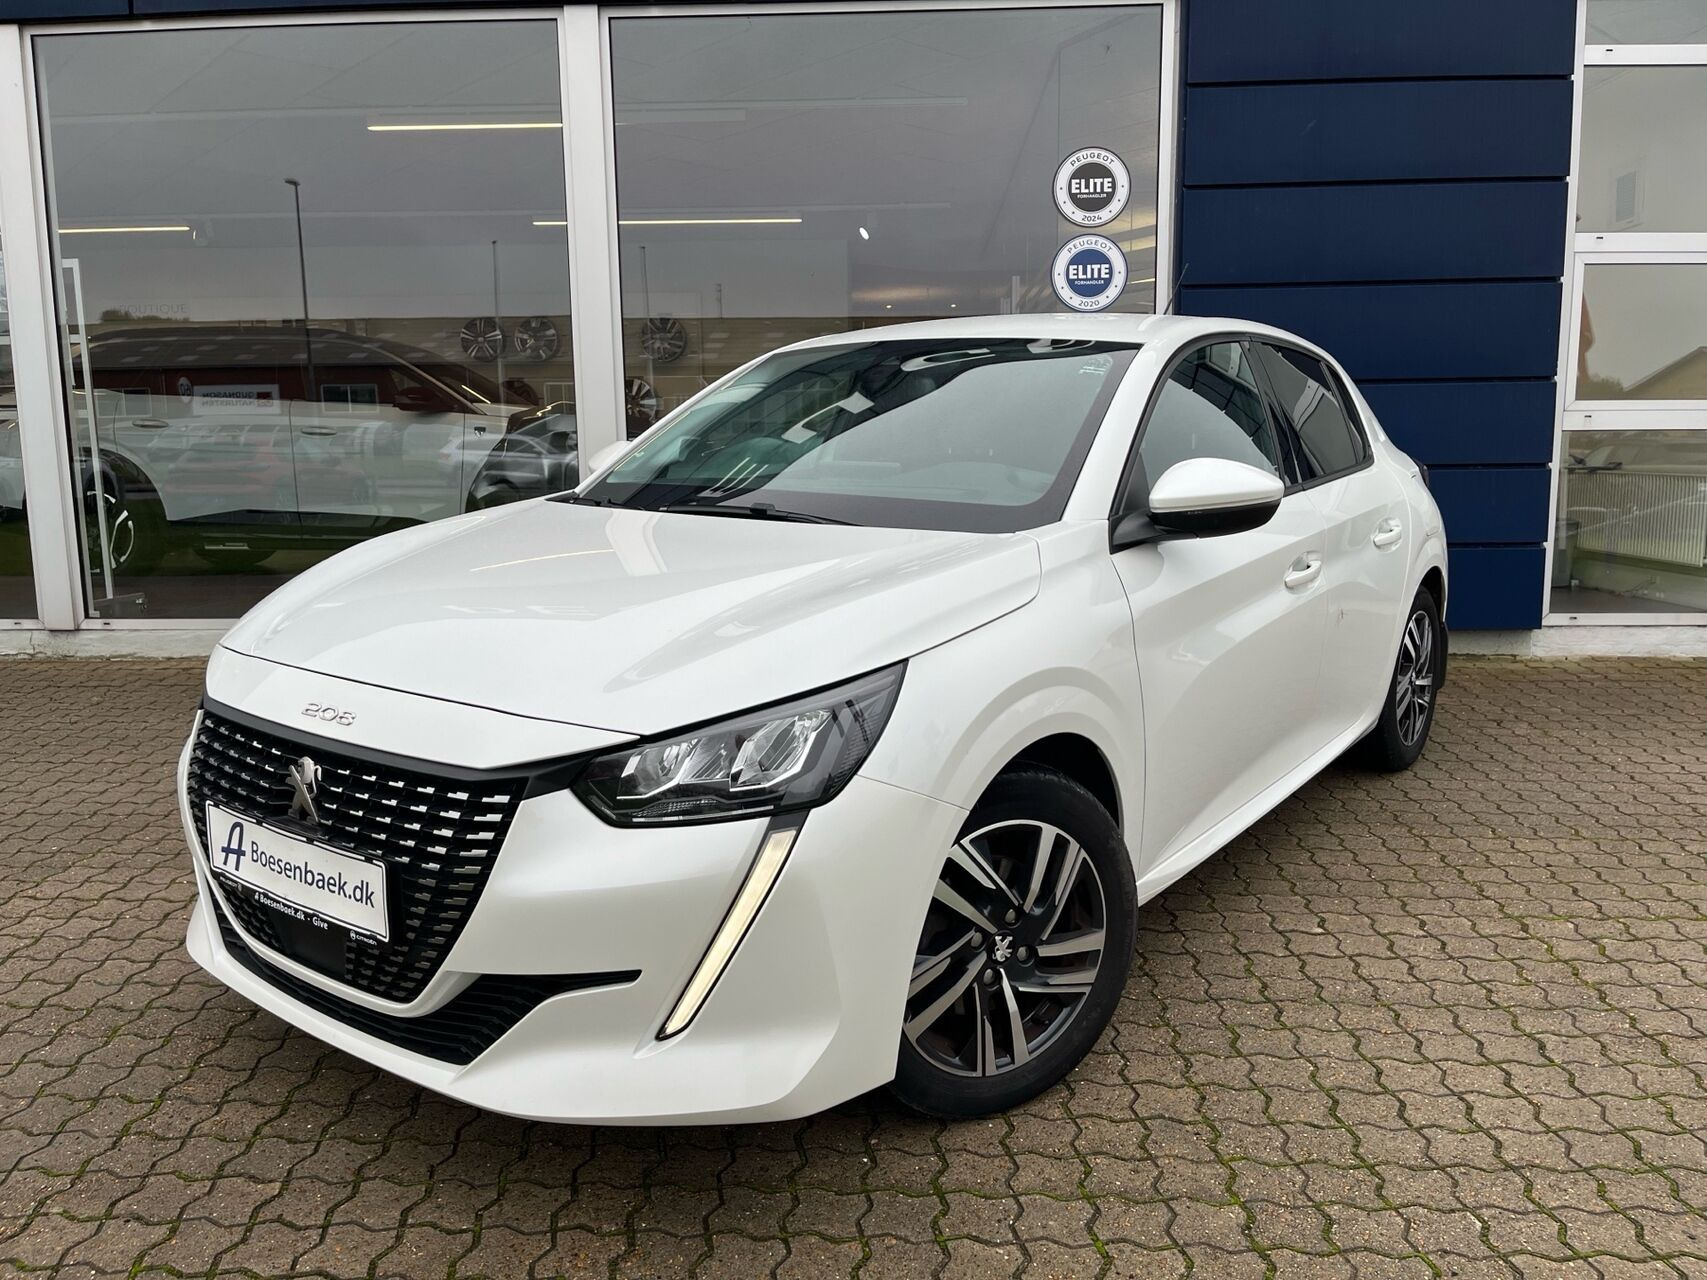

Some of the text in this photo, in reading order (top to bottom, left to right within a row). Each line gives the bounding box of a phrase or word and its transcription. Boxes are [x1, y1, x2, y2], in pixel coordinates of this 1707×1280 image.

[1070, 152, 1115, 167] PEUGEOT
[1071, 178, 1112, 193] ELITE
[1082, 214, 1102, 222] 2024
[1067, 239, 1112, 254] PEUGEOT
[1069, 264, 1109, 279] ELITE
[301, 703, 356, 726] 208
[251, 841, 375, 908] Boesenbaek.dk
[260, 894, 305, 921] Boesenbaek.dk
[312, 916, 328, 930] Give
